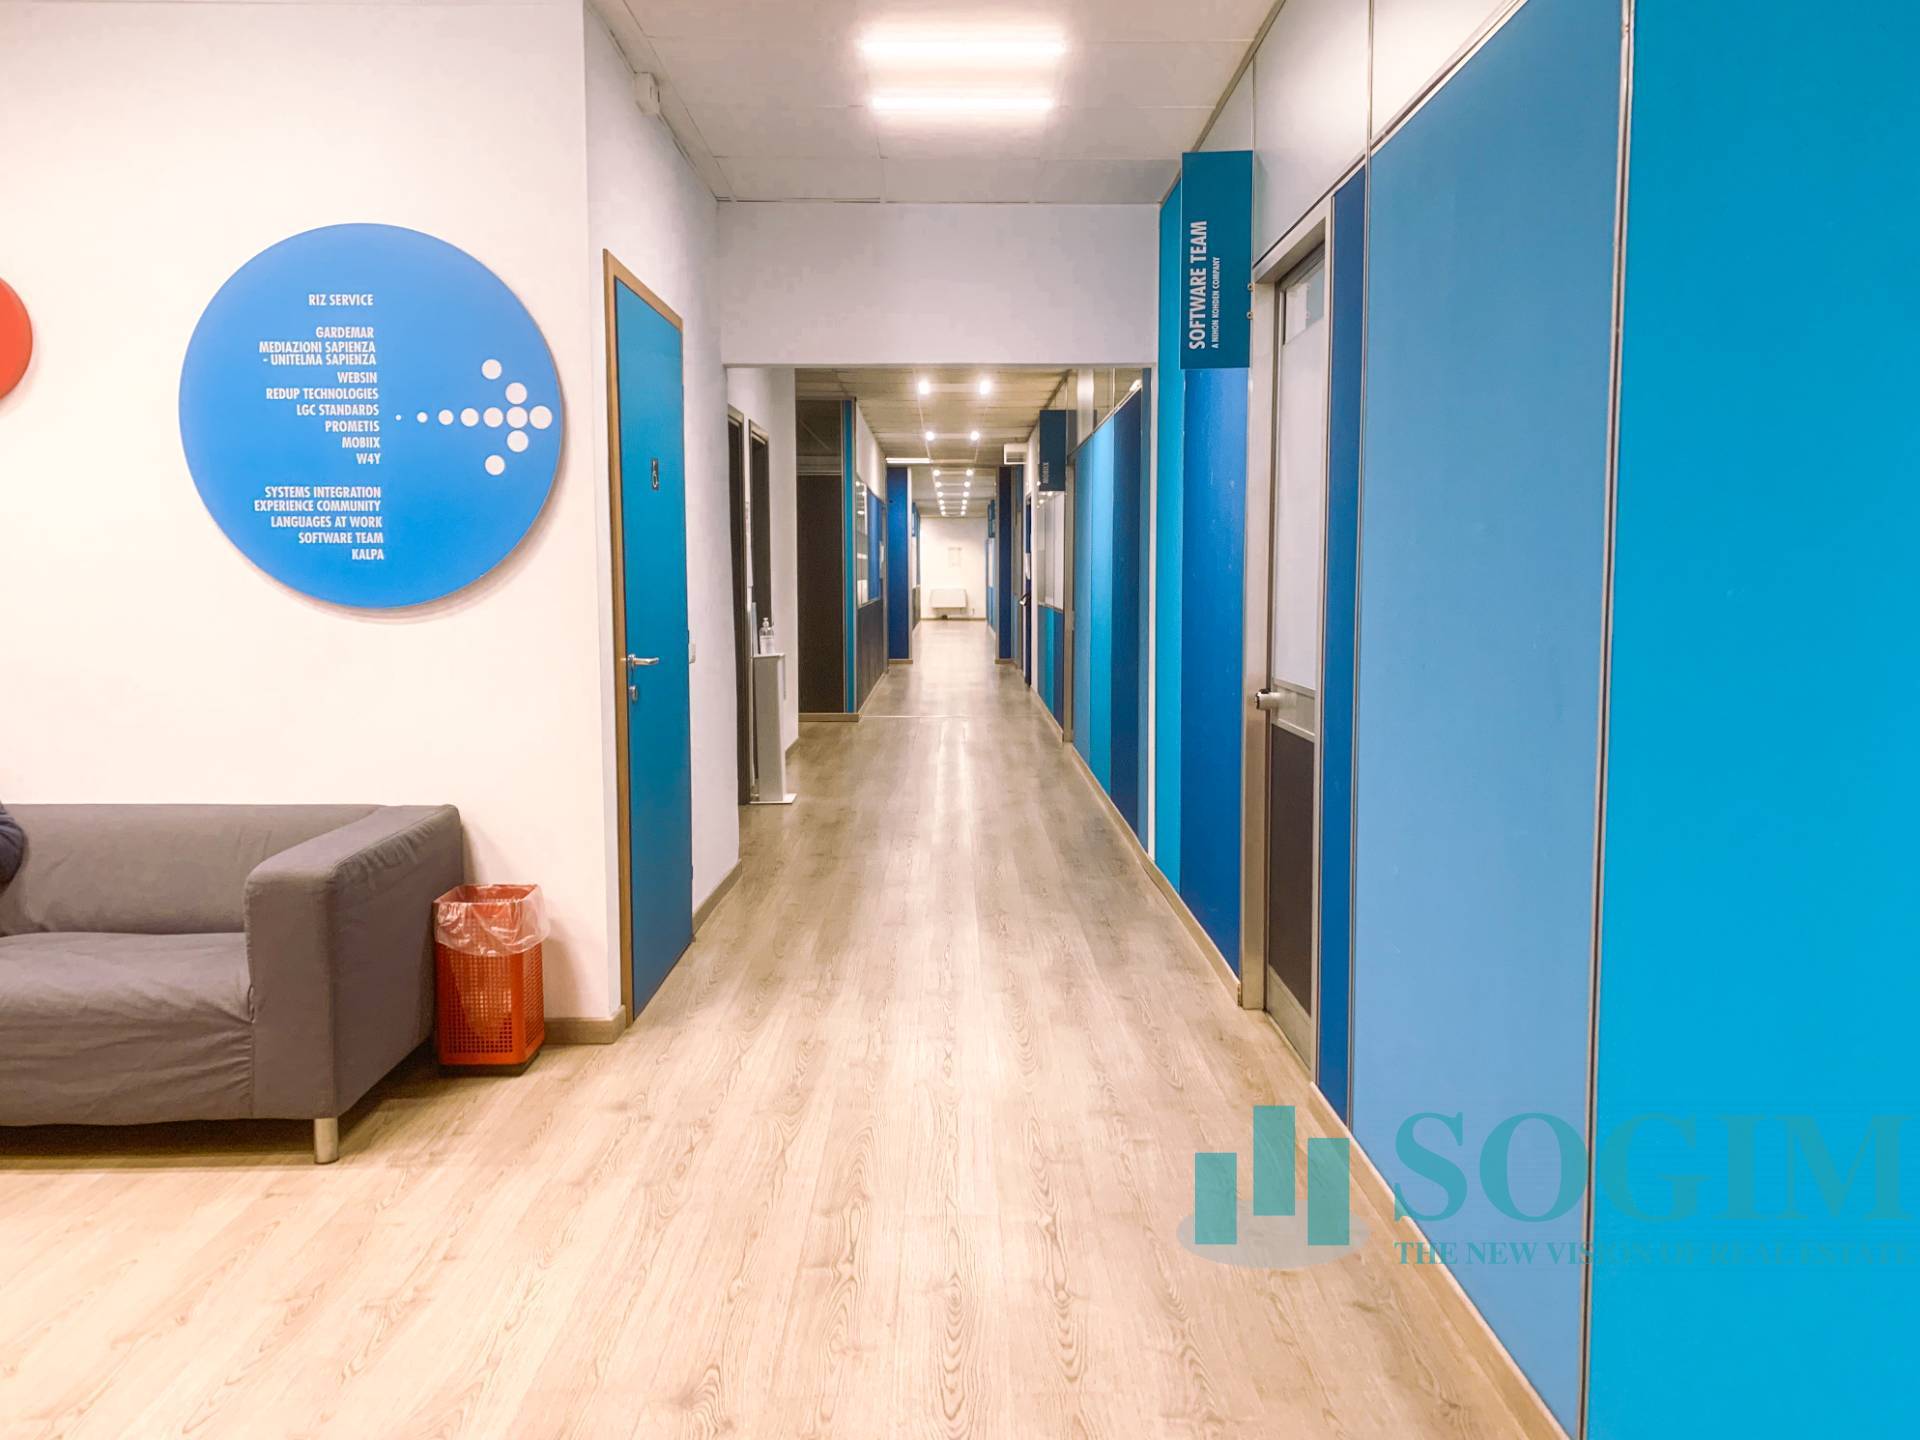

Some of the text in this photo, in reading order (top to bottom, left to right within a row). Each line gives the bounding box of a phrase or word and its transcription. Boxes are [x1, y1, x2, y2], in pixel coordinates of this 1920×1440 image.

[1212, 256, 1221, 289] COMPANY
[1188, 220, 1208, 350] SOFTWARE TEAM
[308, 294, 374, 306] RIZ SERVICE
[315, 326, 375, 339] GARDEMAR
[259, 341, 376, 353] MEDIAZIONI SAPIENZA
[271, 354, 323, 366] UNITELMA
[326, 354, 377, 366] SAPIENZA
[337, 371, 377, 384] WEBSIN
[266, 387, 379, 400] REDUP TECHNOLOGIES
[296, 404, 380, 416] LGC STANDARDS
[325, 420, 380, 432] PROMETIS
[342, 436, 381, 449] MOBIIX
[356, 453, 381, 465] W4Y
[264, 486, 381, 498] SYSTEMS INTEGRATION
[254, 500, 381, 512] EXPERIENCE COMMUNITY
[271, 516, 383, 528] LANGUAGES AT WORK
[298, 532, 384, 544] SOFTWARE TEAM
[351, 548, 385, 560] KALPA
